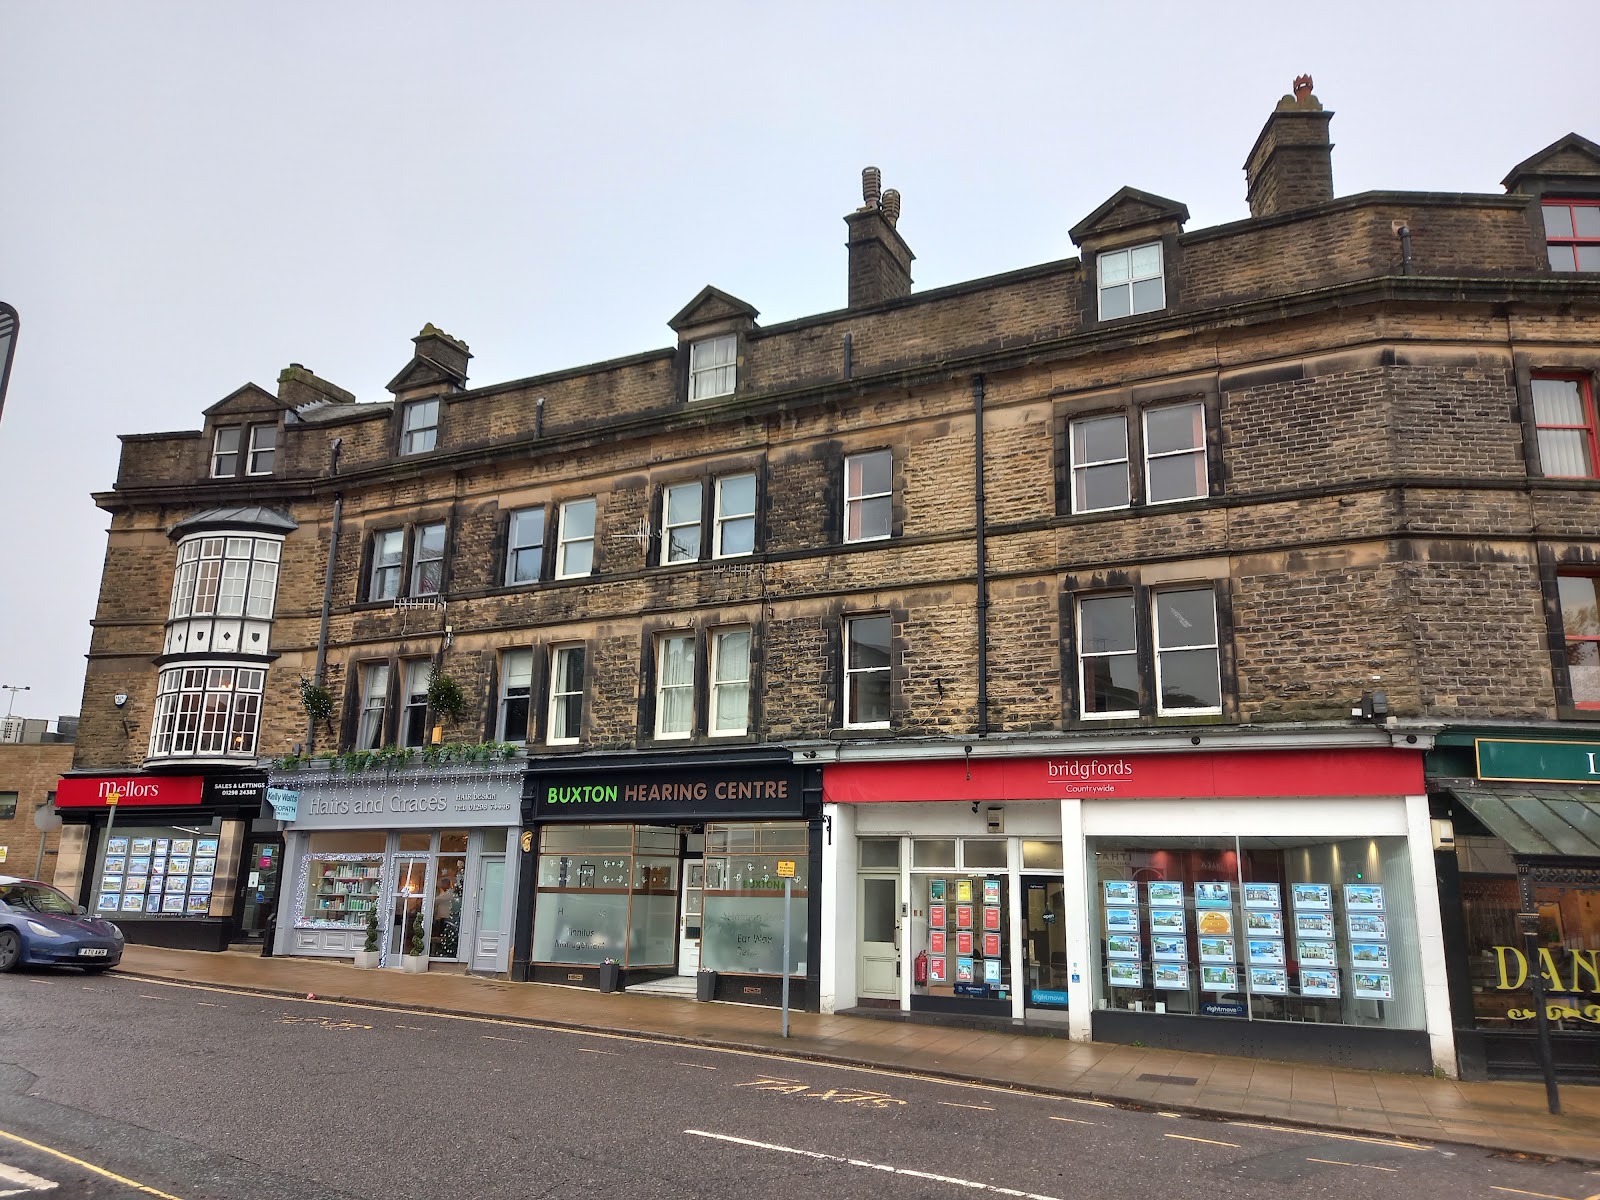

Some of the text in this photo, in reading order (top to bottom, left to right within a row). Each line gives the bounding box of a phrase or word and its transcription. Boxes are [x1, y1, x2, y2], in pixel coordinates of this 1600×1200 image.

[1048, 760, 1132, 779] bridgfords
[547, 780, 788, 803] BUXTON HEARING CENTRE
[1066, 784, 1115, 793] Countrywide
[268, 792, 298, 802] Kelly Watts
[308, 794, 447, 815] Hairs and Graces
[737, 934, 751, 943] Ear
[1033, 994, 1064, 1002] rightmove
[1206, 1005, 1237, 1013] rightmove
